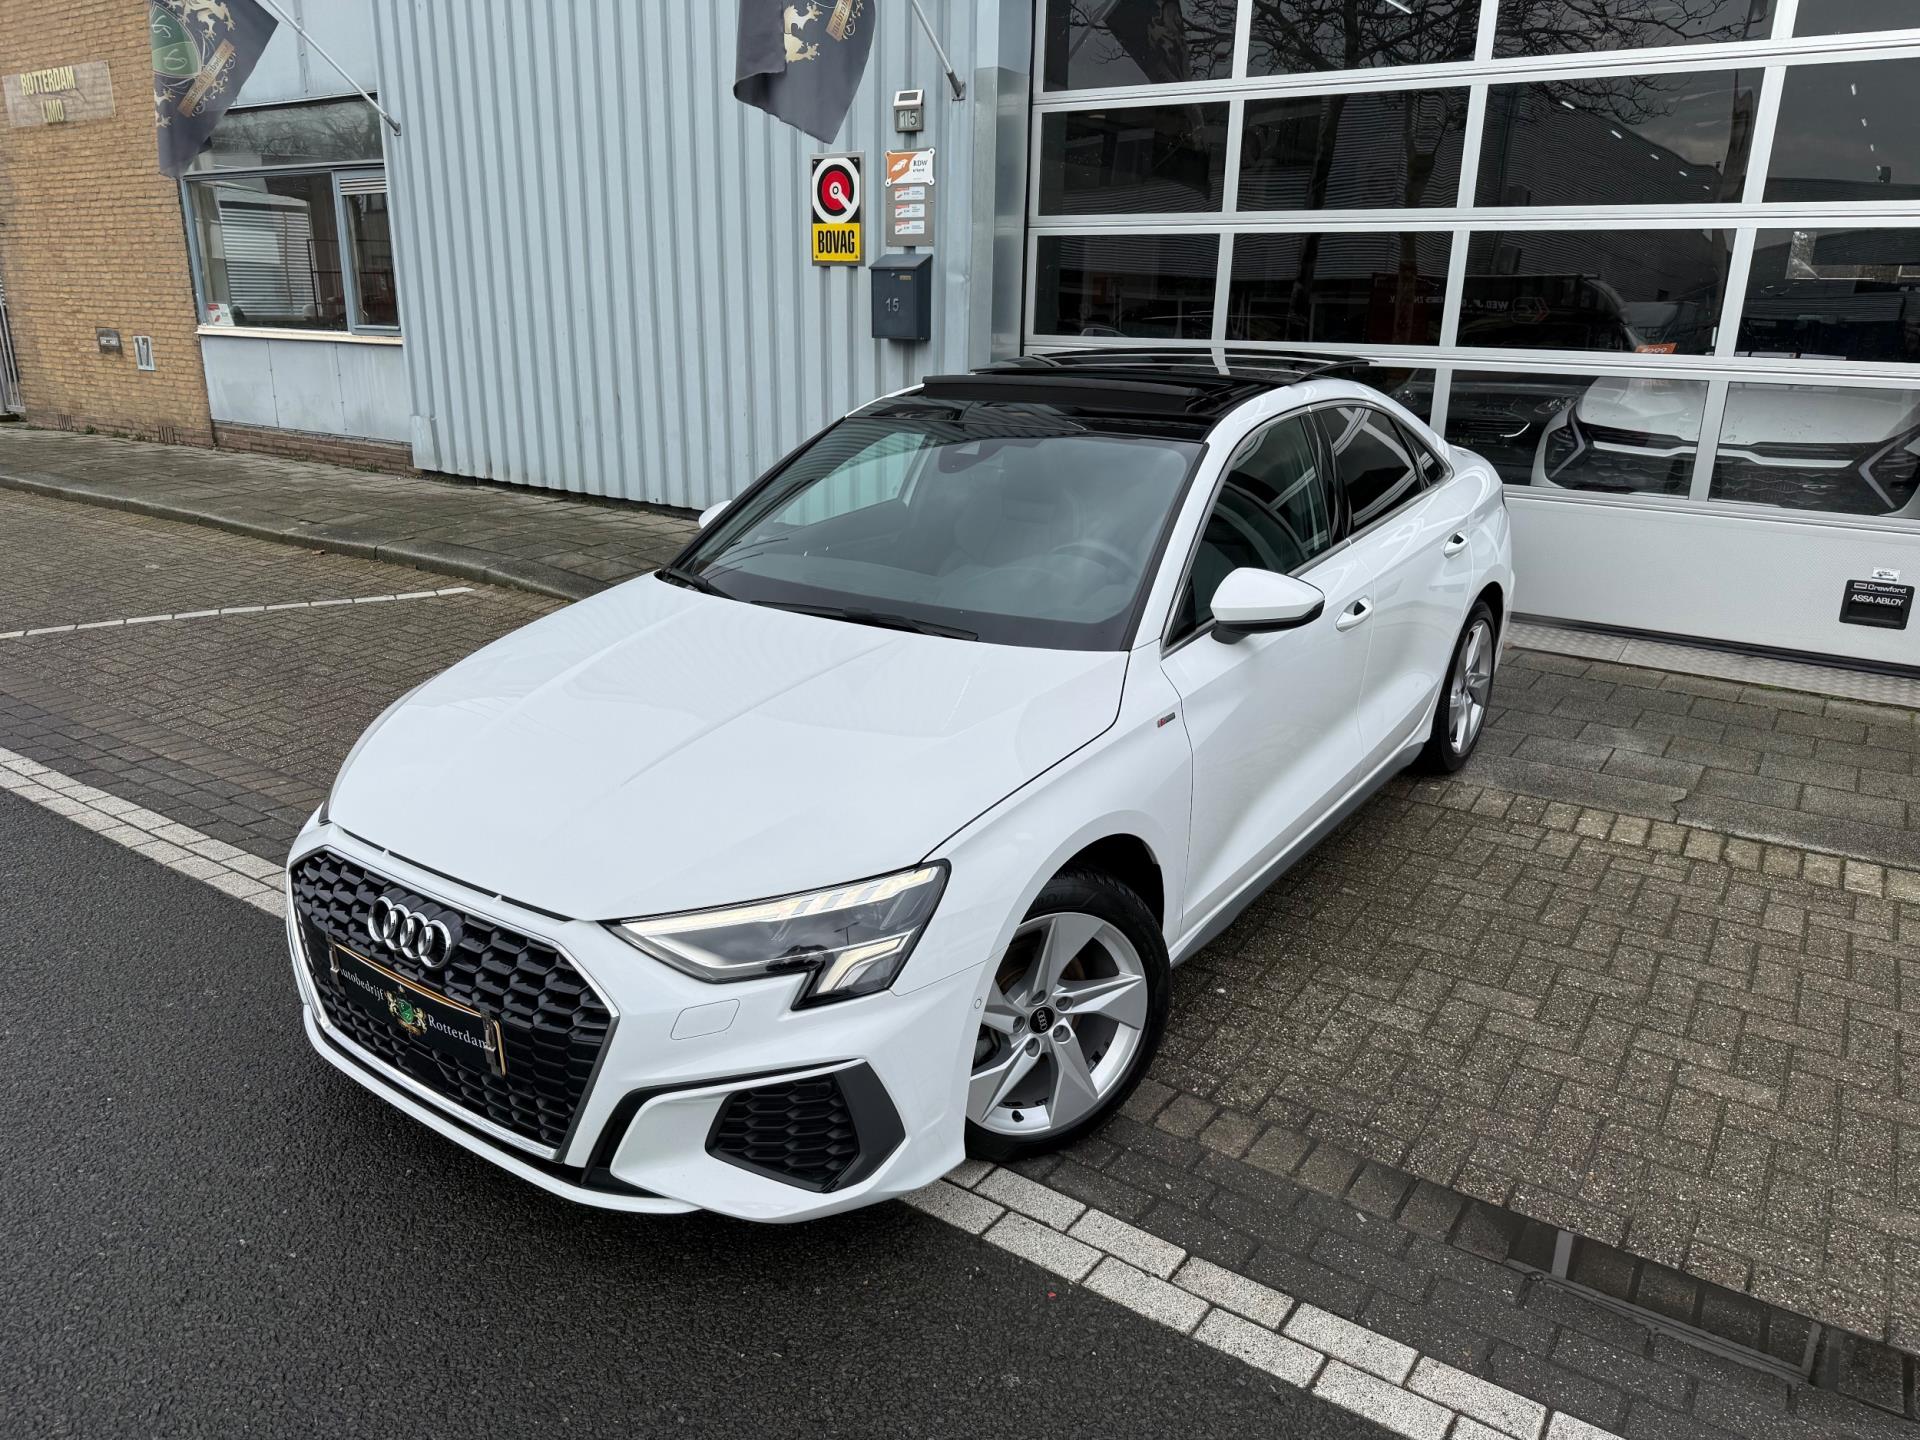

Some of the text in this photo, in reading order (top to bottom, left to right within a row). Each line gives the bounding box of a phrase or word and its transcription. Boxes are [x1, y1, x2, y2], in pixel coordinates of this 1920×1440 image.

[20, 65, 76, 96] ROTTERDAM
[40, 98, 65, 123] LIMO
[900, 111, 917, 126] 15
[913, 159, 928, 167] RDW
[817, 229, 855, 254] BOVAG
[885, 297, 900, 312] 15
[1868, 584, 1906, 593] Crawford
[1852, 594, 1903, 606] ASSA ABLOY
